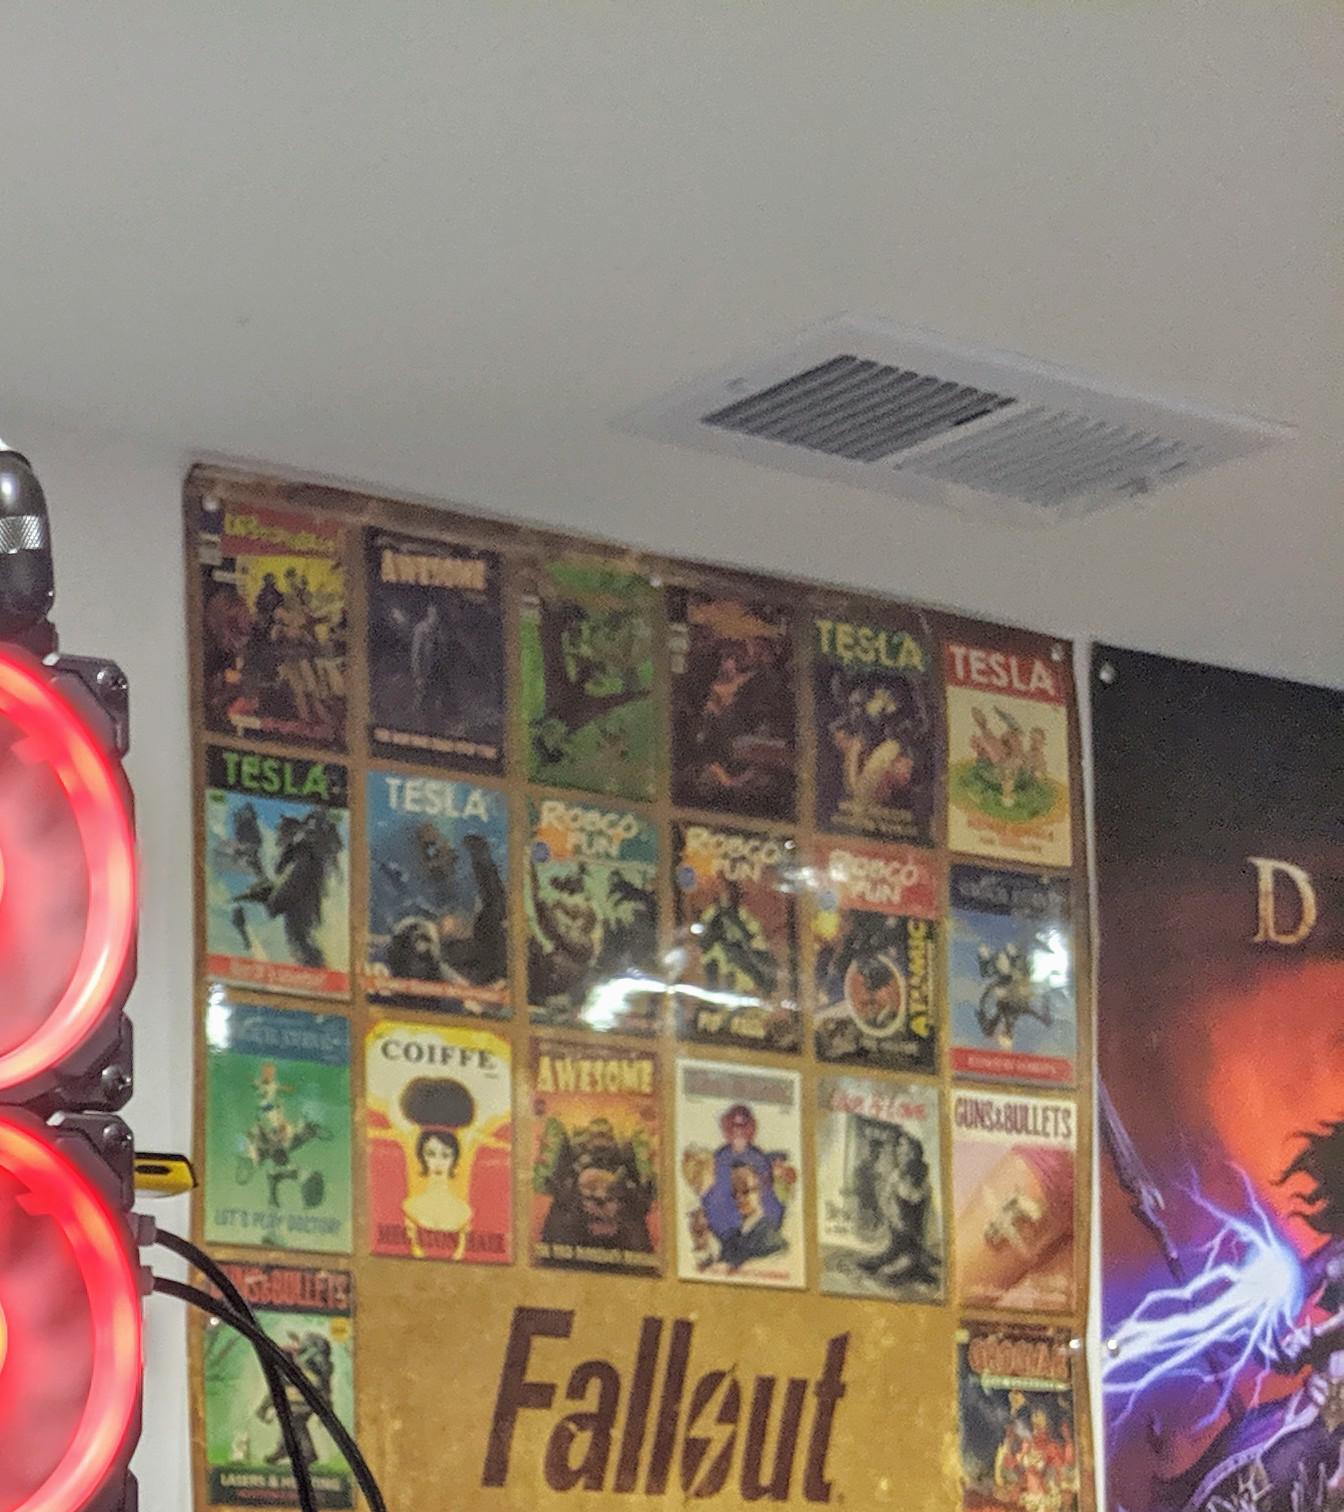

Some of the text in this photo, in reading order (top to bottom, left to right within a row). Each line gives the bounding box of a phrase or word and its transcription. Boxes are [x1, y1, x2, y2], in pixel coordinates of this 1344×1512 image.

[815, 618, 925, 673] TESLA
[950, 643, 1055, 697] TESLA
[223, 752, 328, 796] TESLA
[385, 777, 491, 821] TESLA
[1247, 856, 1317, 944] D
[380, 1037, 498, 1072] COIFFE
[535, 1056, 655, 1095] AWESOME
[481, 1306, 851, 1504] Fallout
